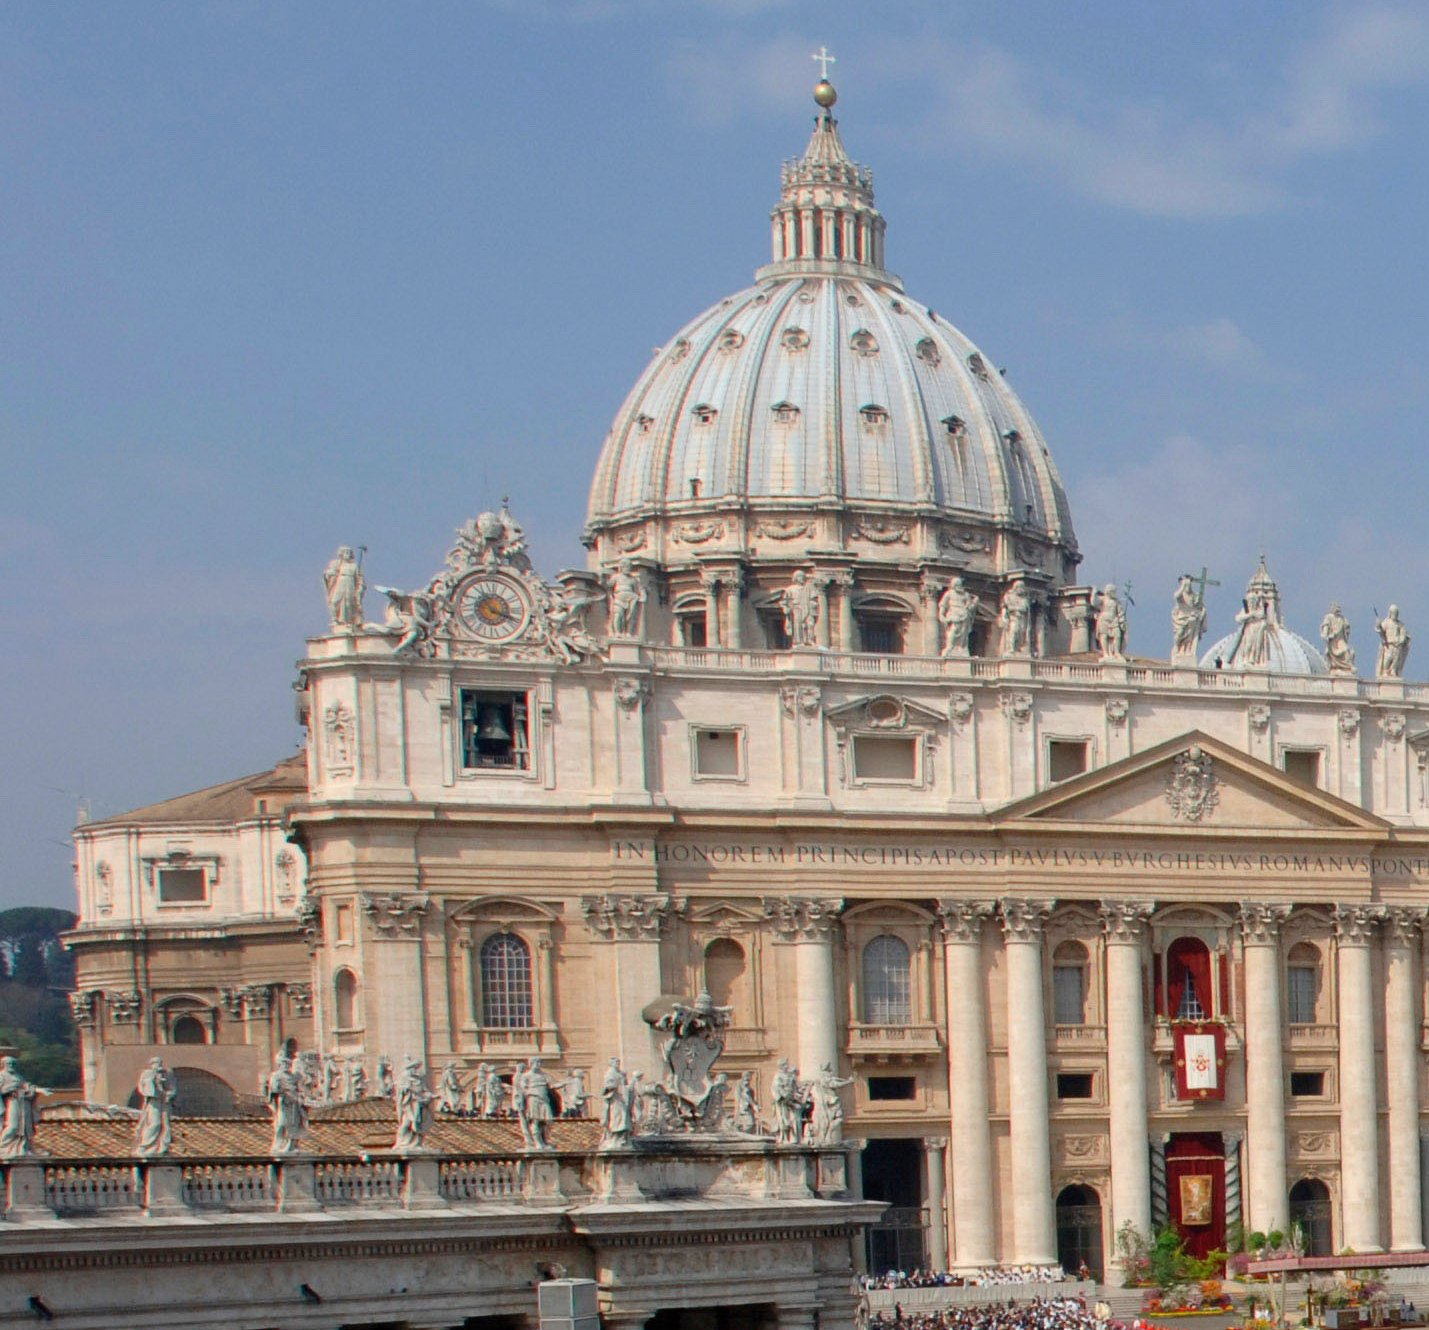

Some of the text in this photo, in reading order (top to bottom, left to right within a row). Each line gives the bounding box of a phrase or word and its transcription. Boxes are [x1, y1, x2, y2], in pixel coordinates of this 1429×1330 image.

[615, 841, 644, 859] IN
[655, 843, 786, 864] HONOREM
[796, 846, 922, 865] PRINCIPIS
[1010, 849, 1088, 867] PAVLVS
[1113, 852, 1252, 871] BVRGHESIVS
[1259, 854, 1372, 873] ROMANVS
